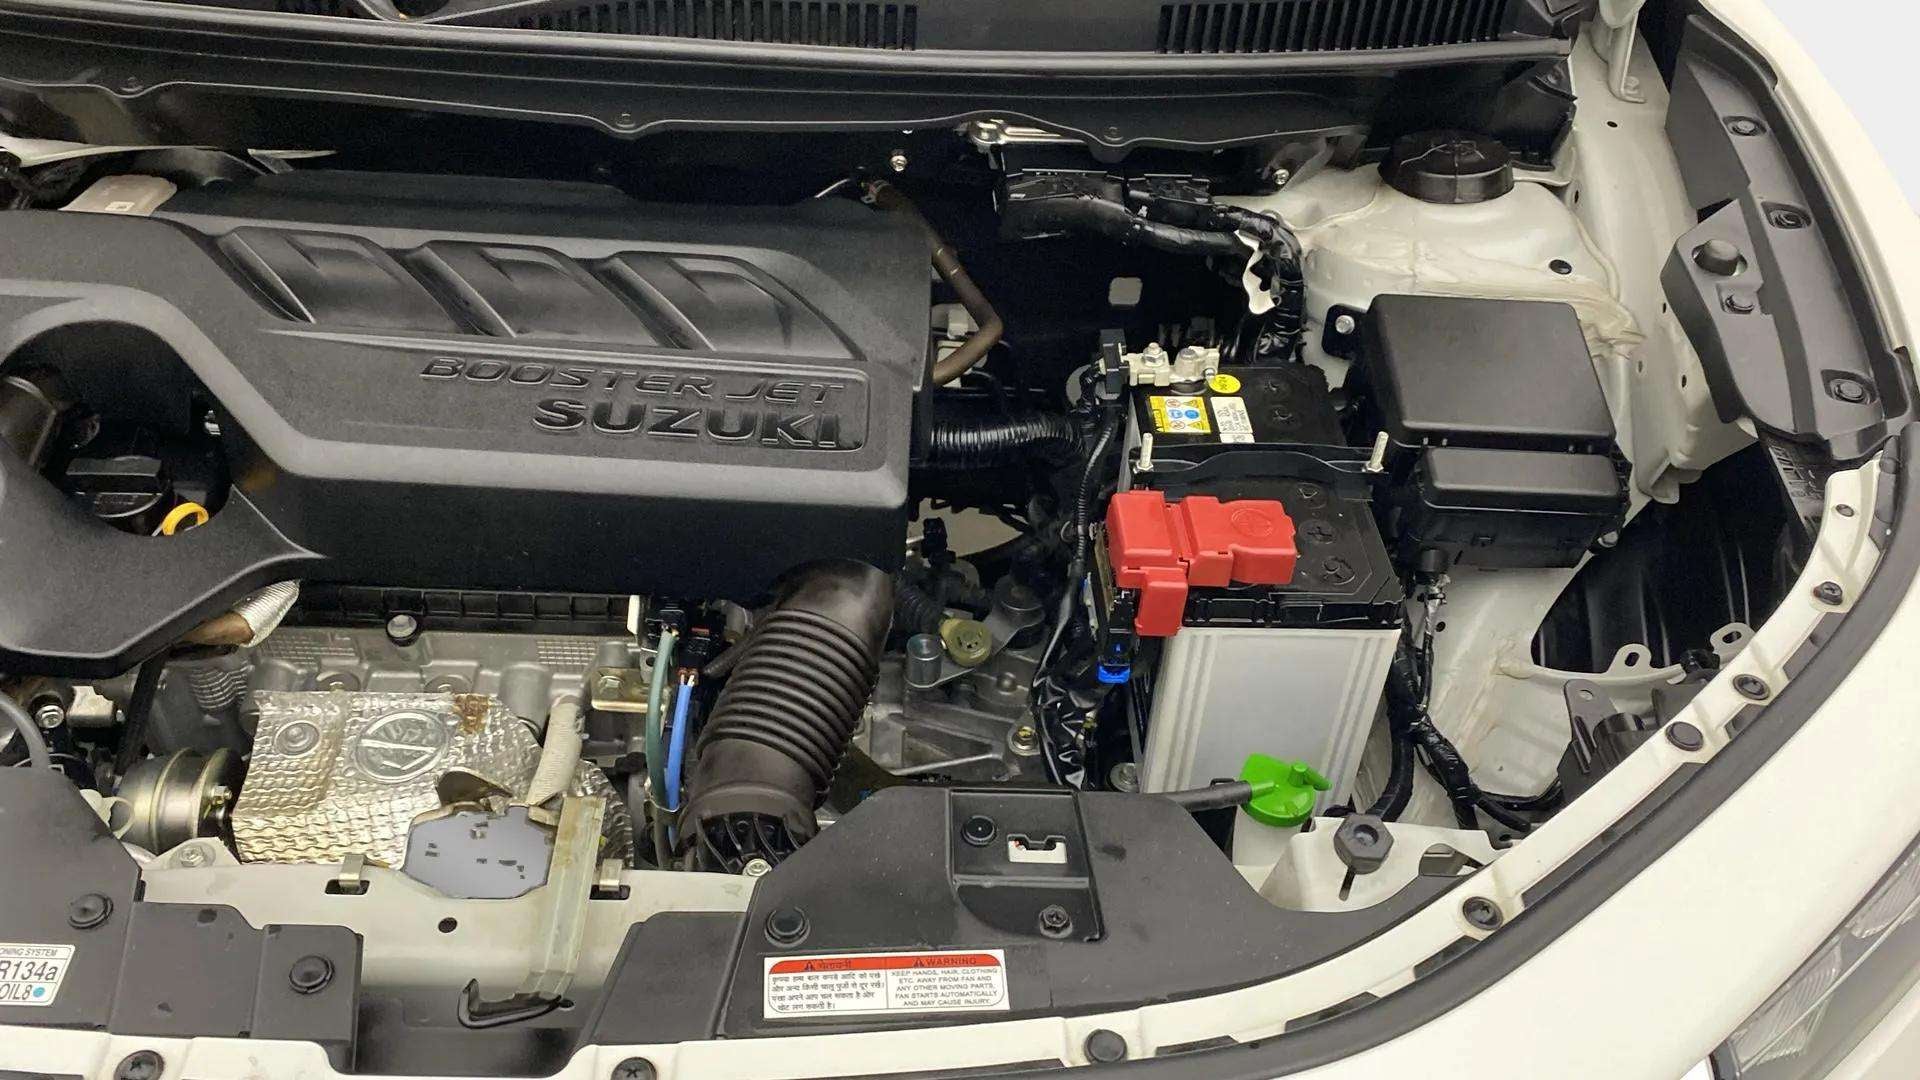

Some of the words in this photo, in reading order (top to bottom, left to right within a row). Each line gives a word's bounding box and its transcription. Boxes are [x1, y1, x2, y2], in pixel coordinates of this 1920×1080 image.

[419, 356, 714, 399] BOOSTER
[725, 376, 846, 405] JET
[531, 398, 840, 449] SUZUKI
[25, 948, 58, 957] SYSTEM
[926, 957, 976, 965] WARNING
